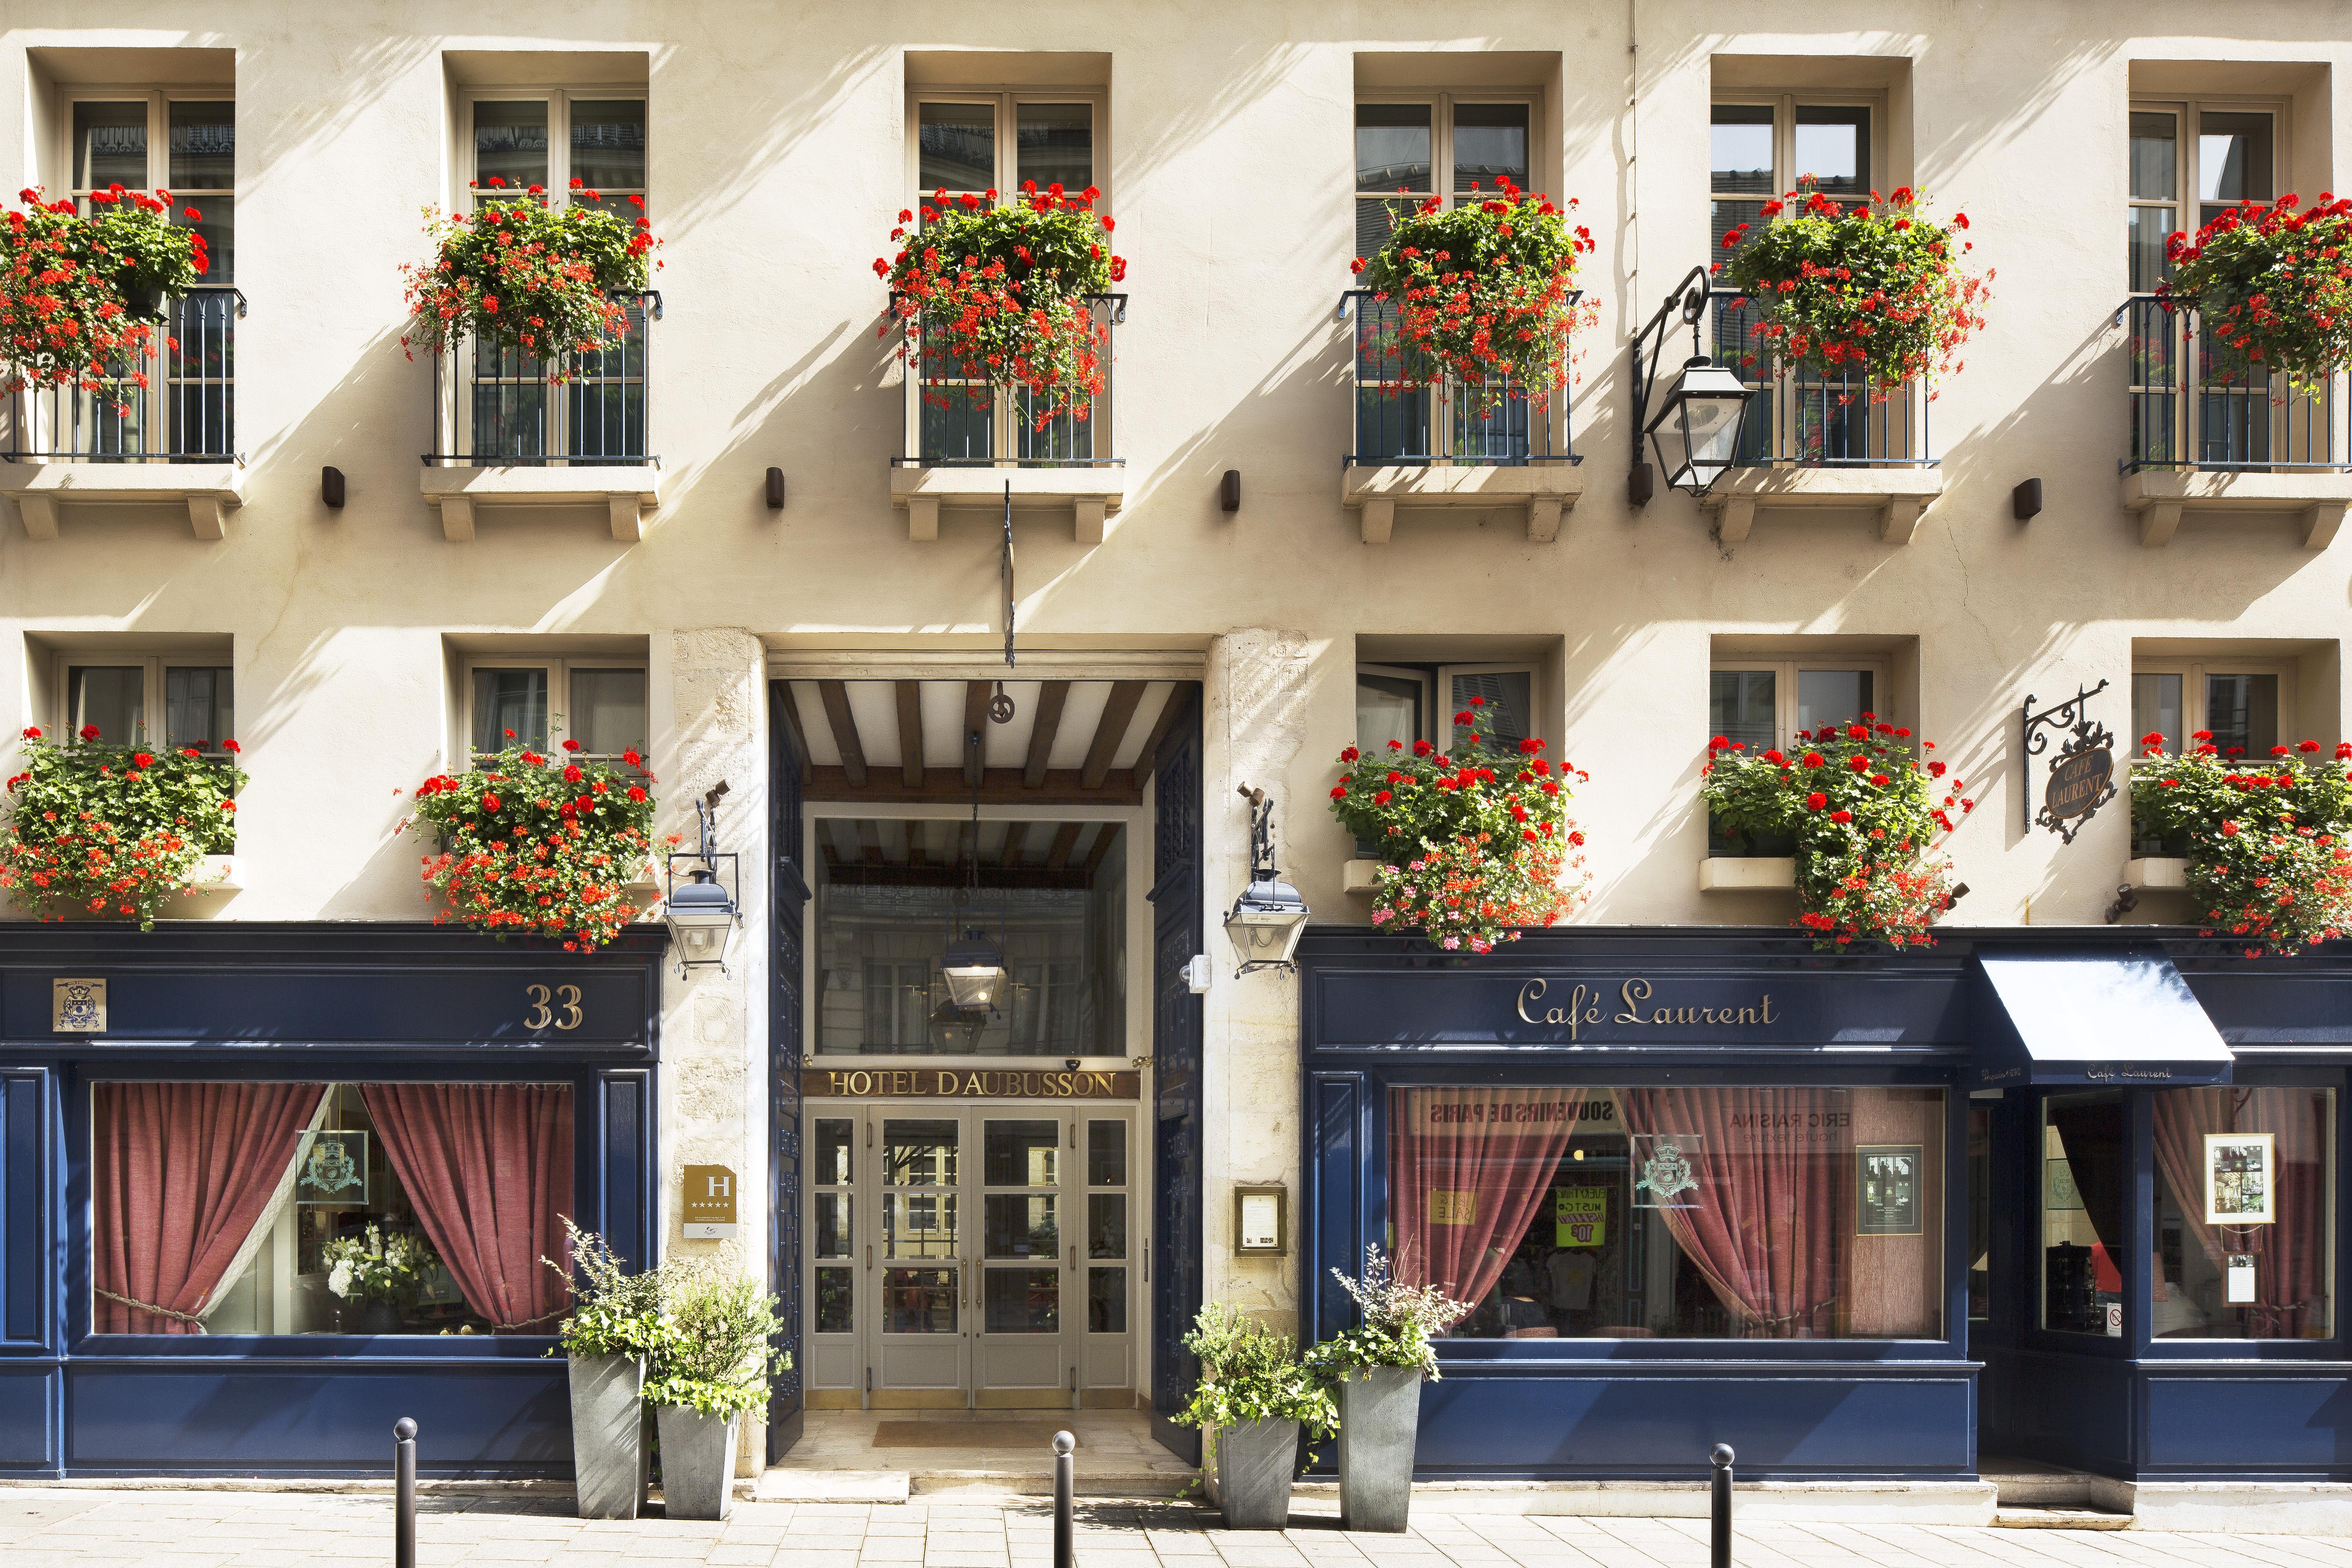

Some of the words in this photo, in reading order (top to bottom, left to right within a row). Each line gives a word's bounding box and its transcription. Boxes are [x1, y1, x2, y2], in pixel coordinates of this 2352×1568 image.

[2065, 755, 2094, 781] CAFE
[2052, 773, 2103, 808] LAURENT
[523, 984, 583, 1029] 33
[1517, 978, 1607, 1040] Café
[1614, 978, 1781, 1024] Laurent
[828, 1071, 927, 1096] HOTEL
[2087, 1062, 2116, 1082] Café
[2121, 1062, 2172, 1078] Laurent
[706, 1176, 732, 1197] H
